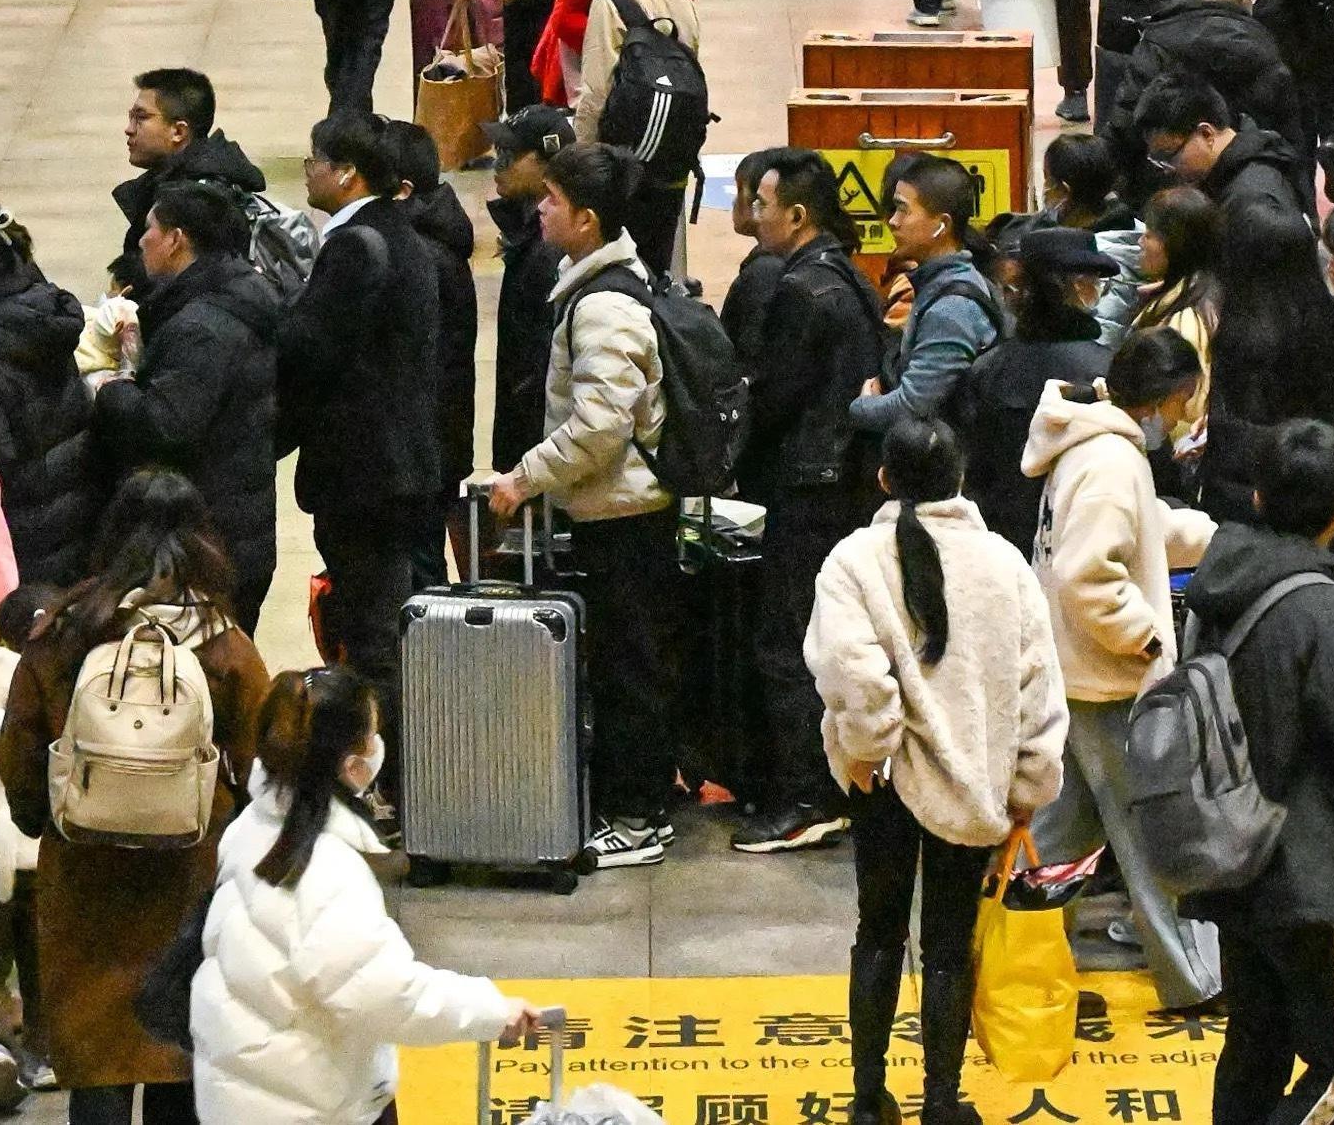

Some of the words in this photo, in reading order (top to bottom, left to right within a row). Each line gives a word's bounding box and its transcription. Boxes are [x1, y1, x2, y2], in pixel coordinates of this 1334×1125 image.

[568, 1057, 708, 1072] attention
[720, 1056, 749, 1070] to
[761, 1055, 809, 1069] the
[1088, 1050, 1139, 1065] the
[1149, 1050, 1218, 1067] adja
